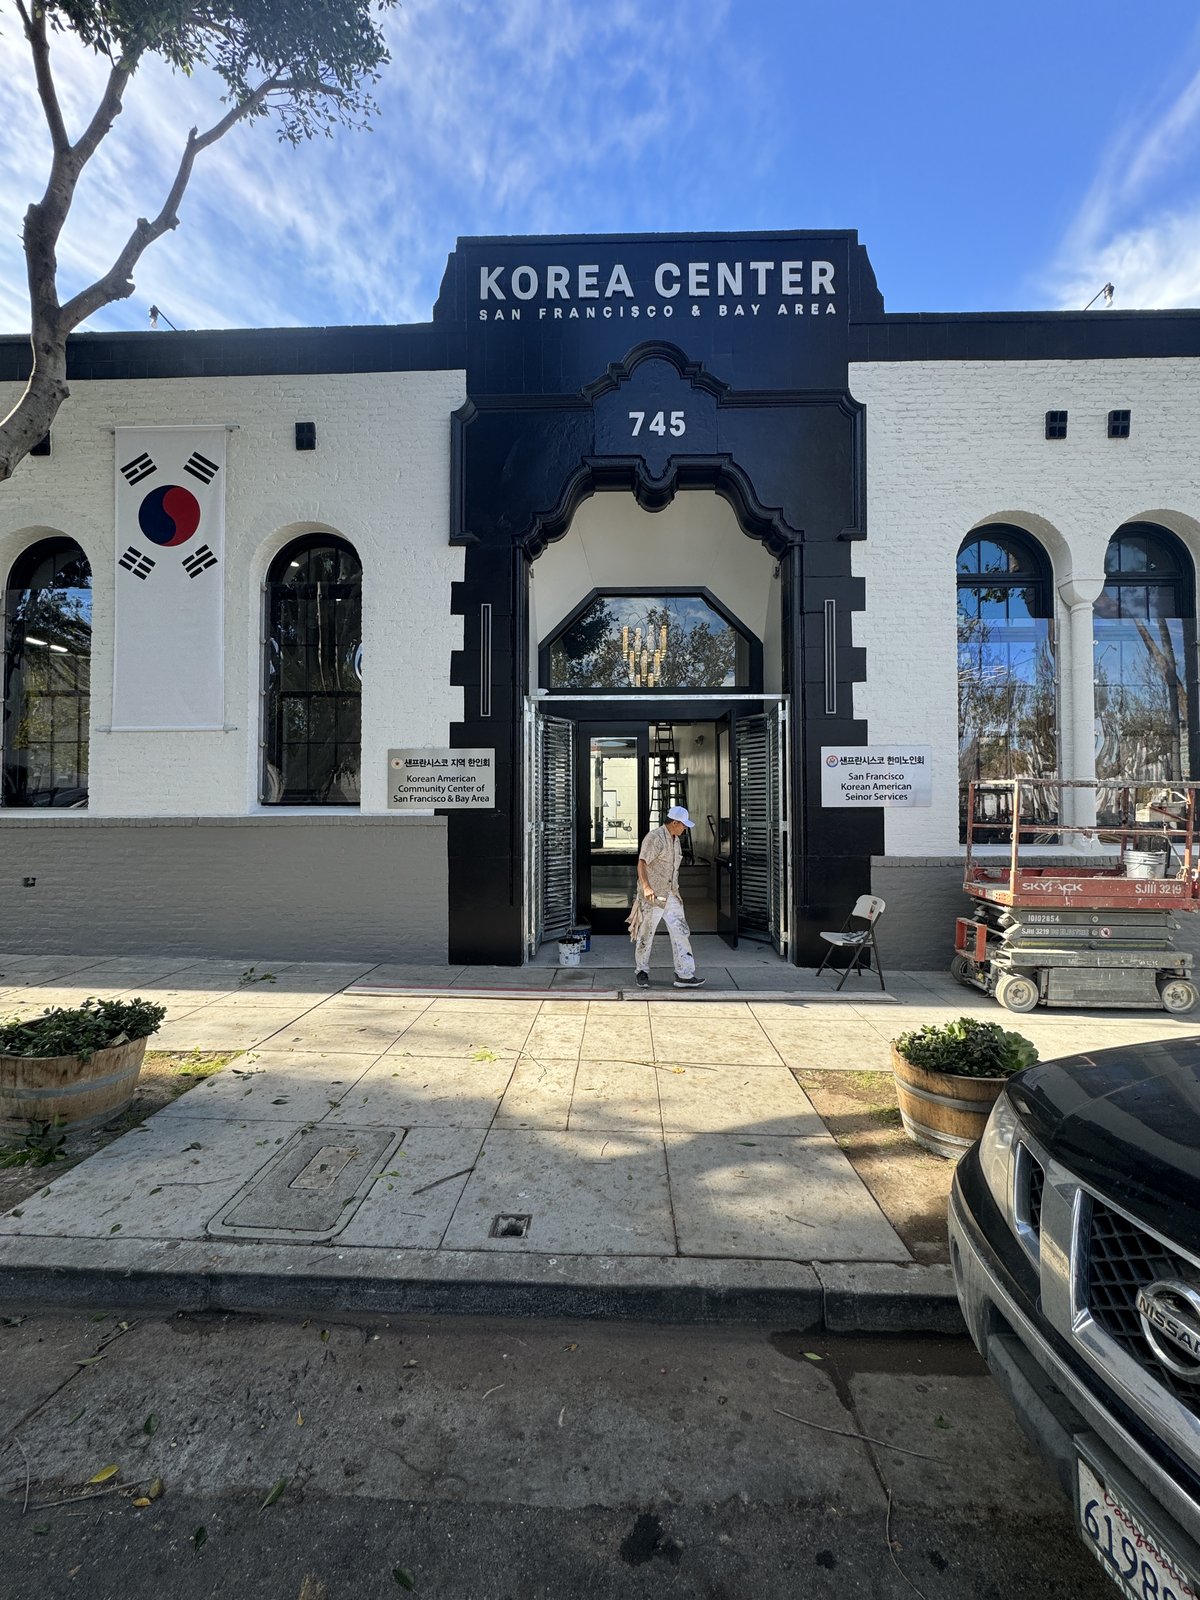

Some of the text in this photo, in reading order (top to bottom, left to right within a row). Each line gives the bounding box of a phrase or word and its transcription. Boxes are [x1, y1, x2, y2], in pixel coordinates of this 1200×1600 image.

[480, 260, 836, 300] KOREA CENTER
[479, 303, 836, 321] SAN FRANCISCO & BAY AREA
[629, 411, 686, 437] 745
[451, 758, 466, 768] 지역
[468, 758, 490, 768] 한인회
[840, 755, 925, 766] 샌프란시스코 한미노인회
[406, 775, 476, 783] Korean American
[848, 772, 905, 781] San Francisco
[398, 784, 485, 794] Community Center of
[841, 783, 912, 791] Korean American
[393, 794, 490, 804] San Francisco & Bay Area
[845, 793, 908, 801] Seinor Services
[1159, 884, 1182, 894] 3219
[1108, 1488, 1189, 1585] OXNARD
